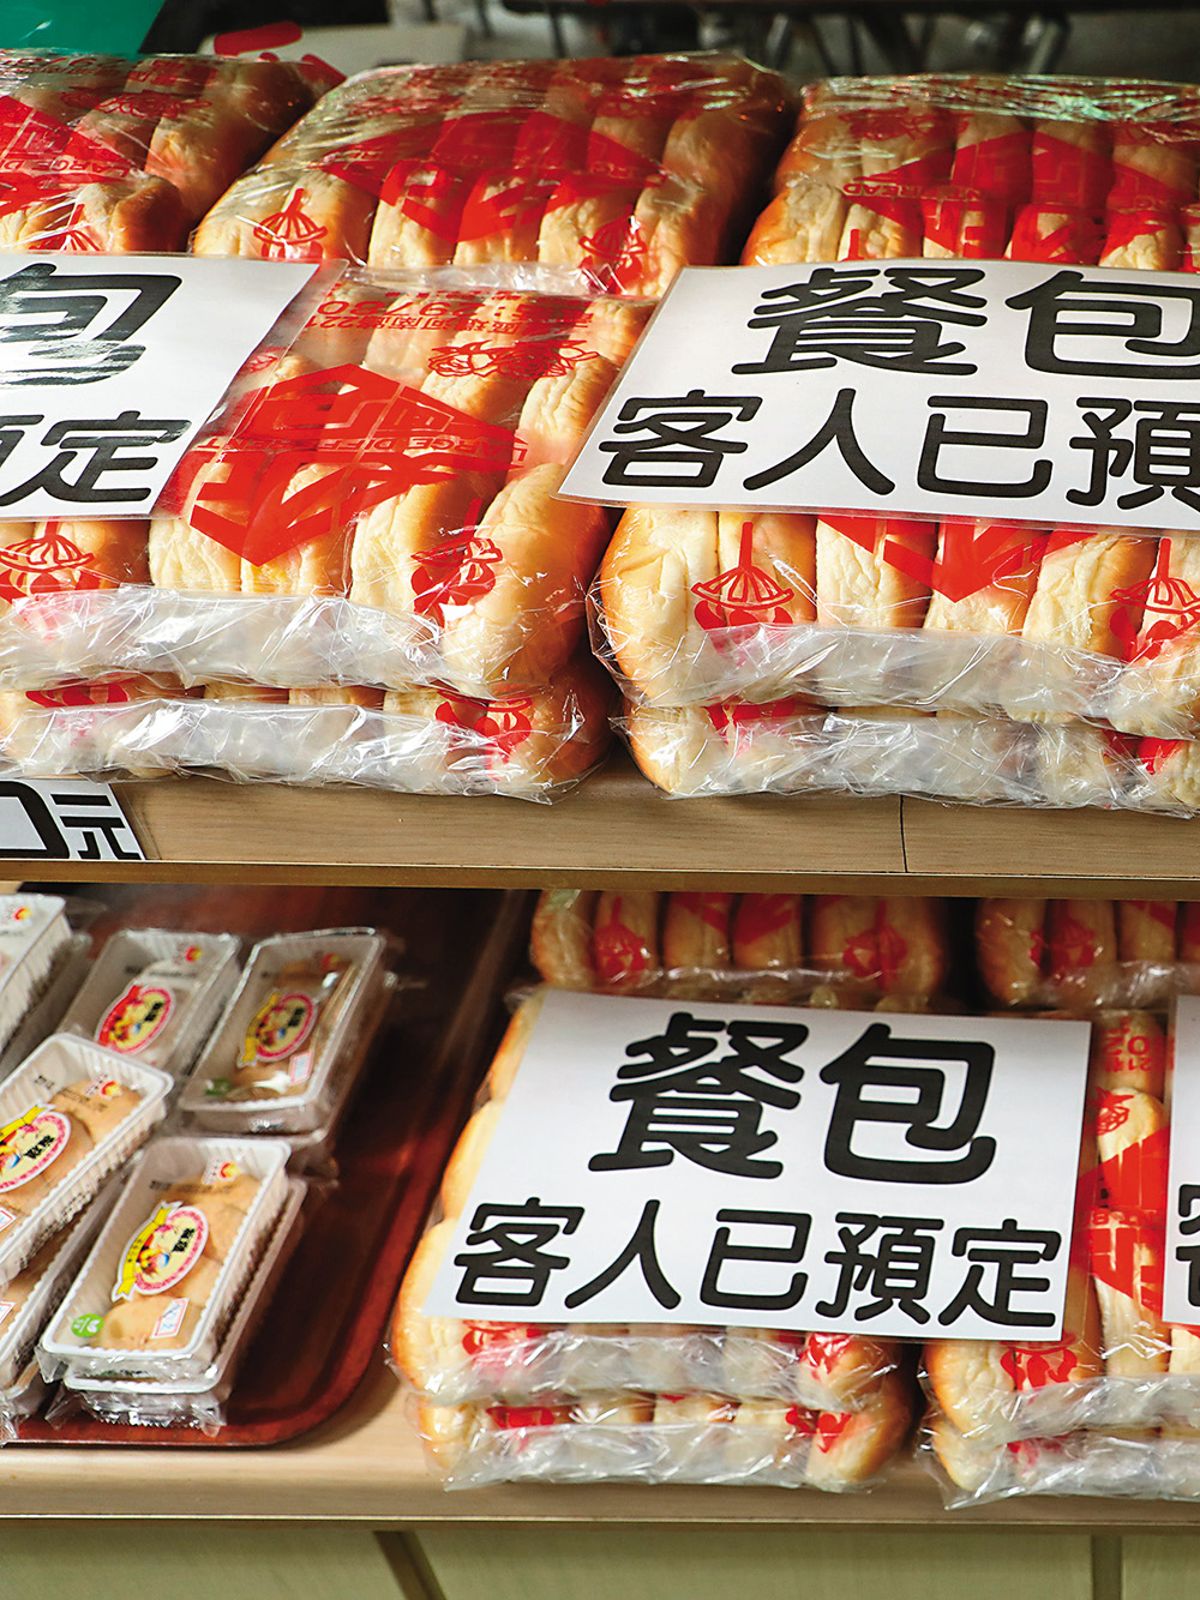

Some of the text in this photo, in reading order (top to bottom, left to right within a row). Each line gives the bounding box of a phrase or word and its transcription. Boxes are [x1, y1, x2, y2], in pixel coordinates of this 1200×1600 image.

[588, 1012, 997, 1184] 餐包
[454, 1198, 1061, 1328] 客人已預定
